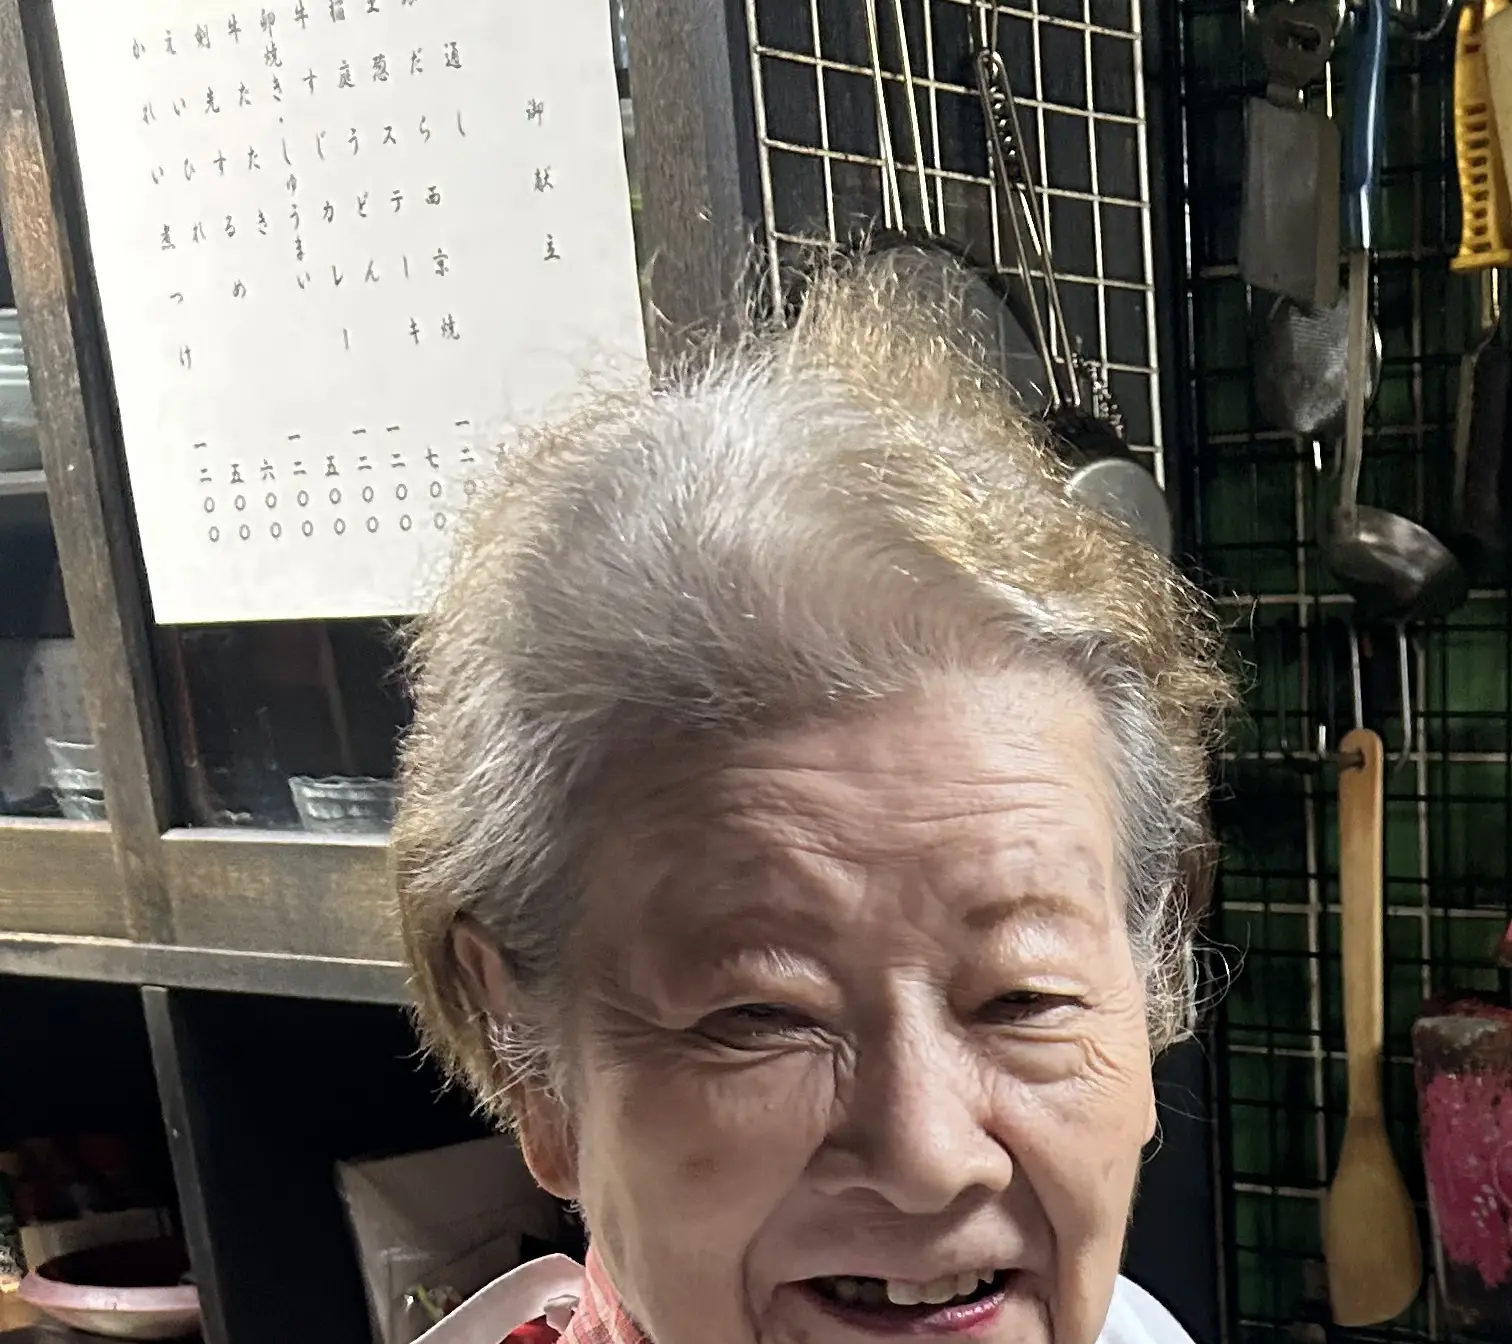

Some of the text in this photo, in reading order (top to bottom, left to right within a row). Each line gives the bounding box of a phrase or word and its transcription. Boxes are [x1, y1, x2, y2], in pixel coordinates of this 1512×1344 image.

[227, 13, 268, 236] 牛たたき
[294, 0, 350, 350] 牛すじカレー
[402, 0, 461, 341] だら西京焼
[526, 98, 561, 261] 御献立
